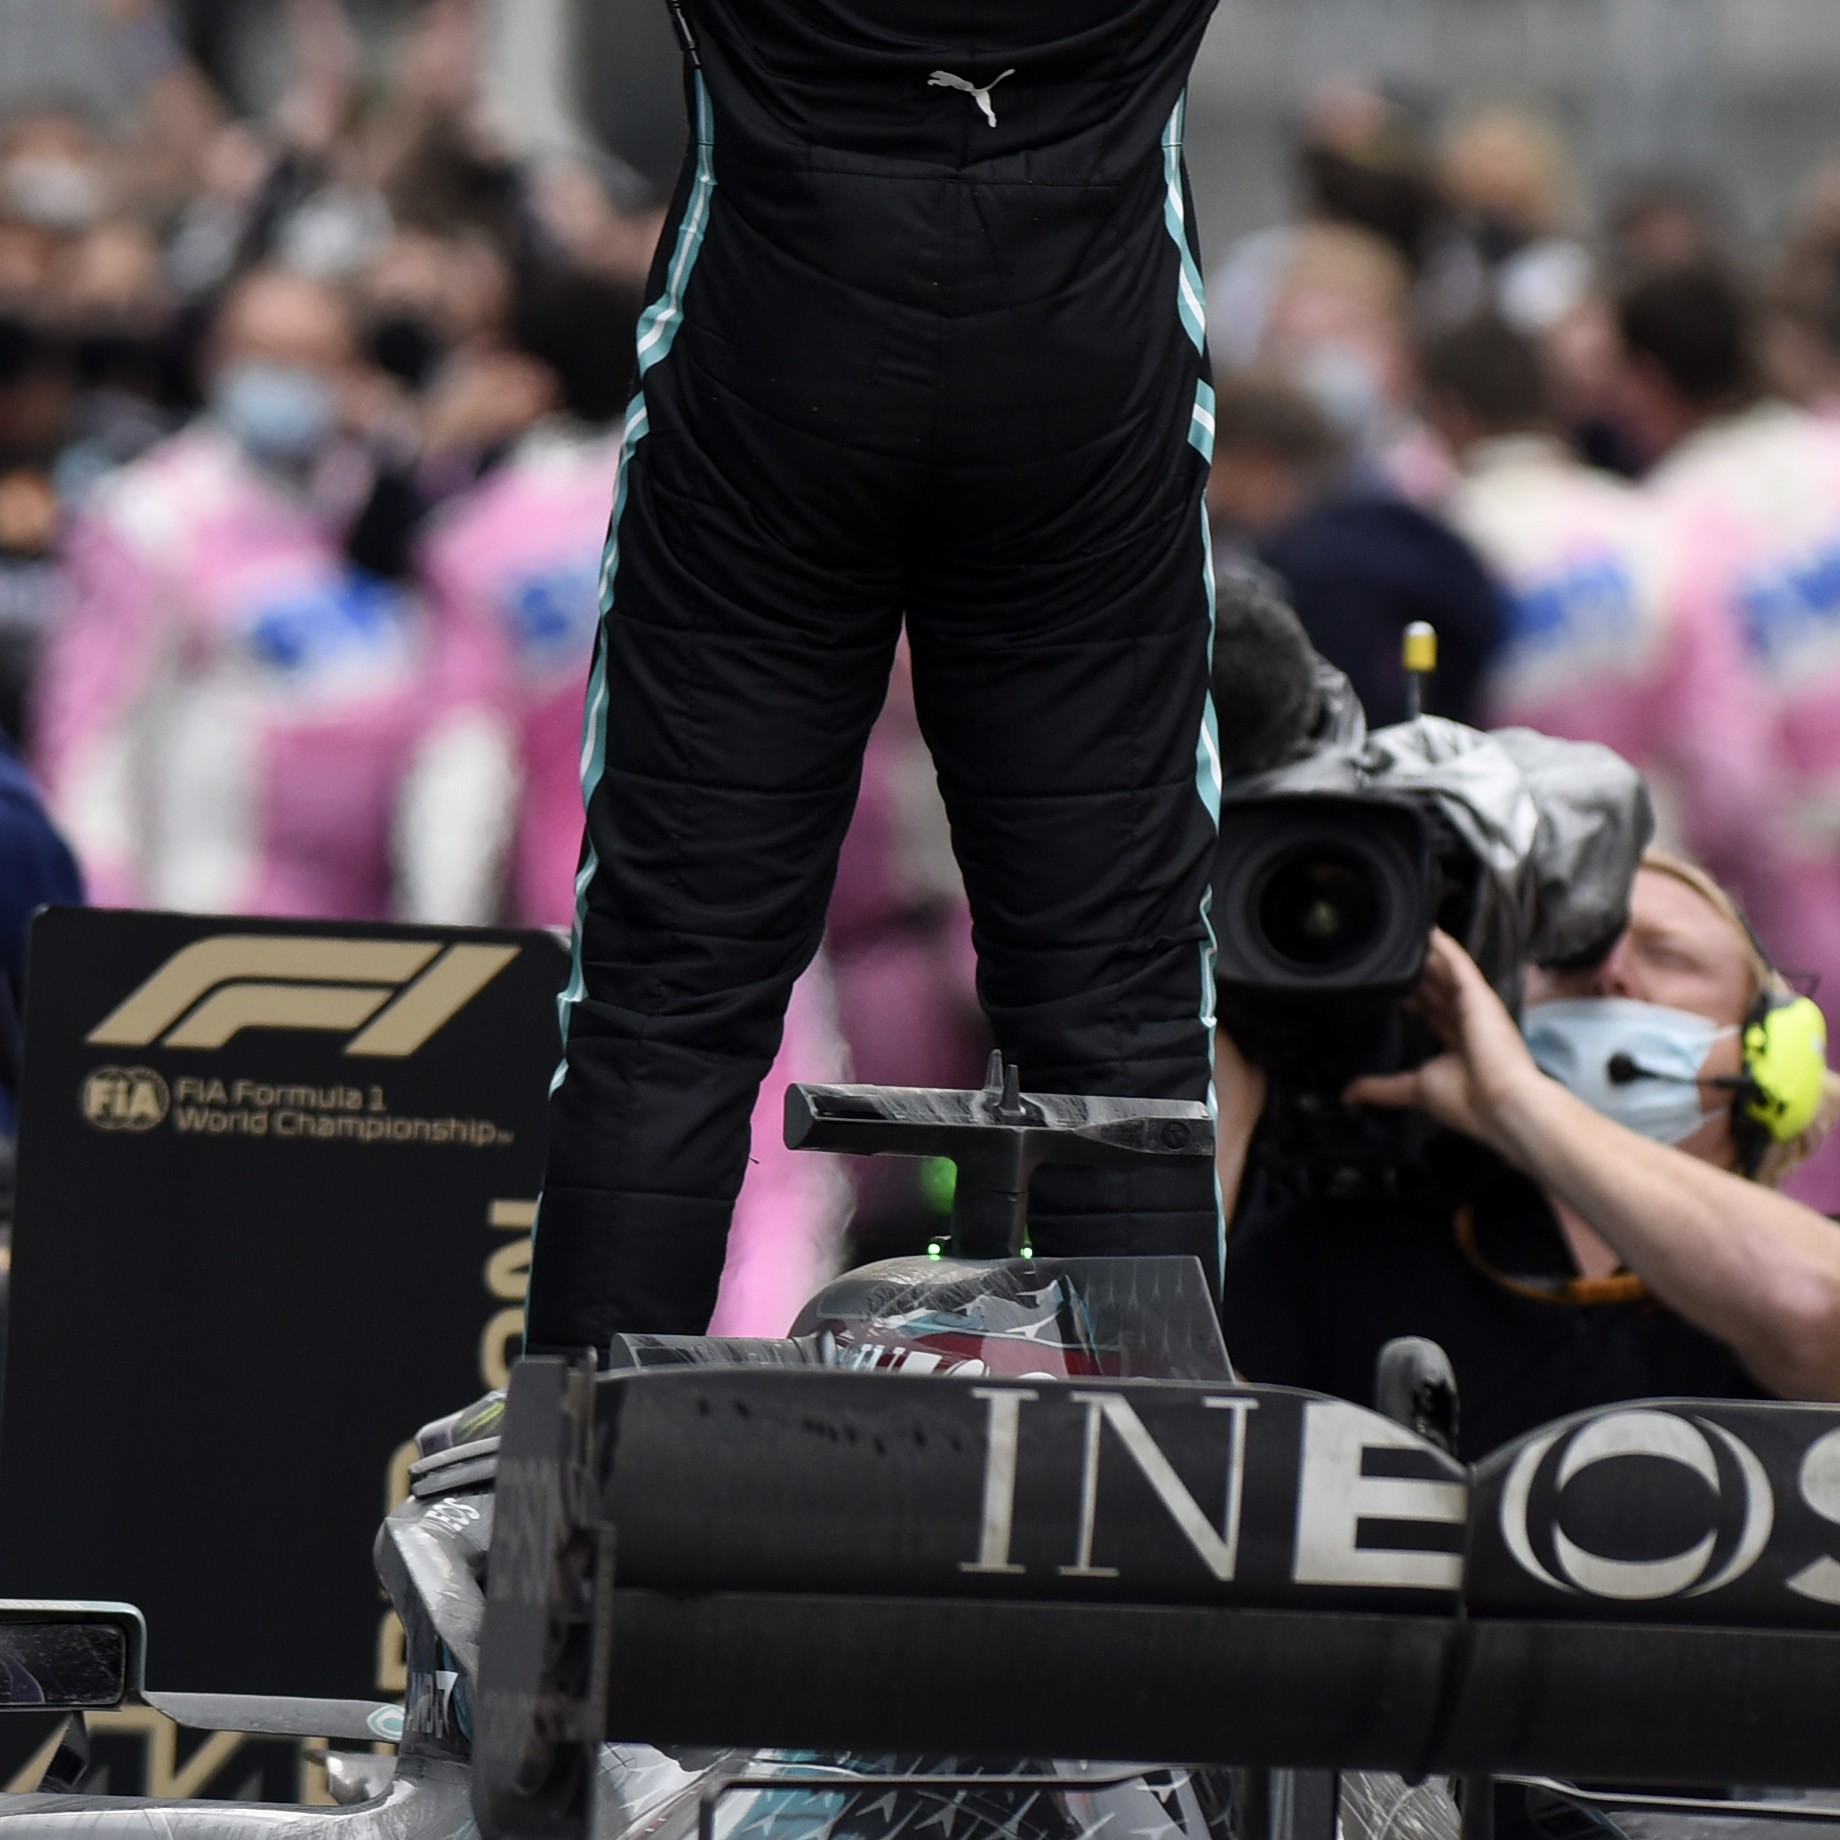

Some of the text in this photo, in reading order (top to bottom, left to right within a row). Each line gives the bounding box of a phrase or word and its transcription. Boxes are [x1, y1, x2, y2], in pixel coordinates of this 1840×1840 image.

[84, 932, 523, 1058] F1
[178, 1078, 387, 1111] FIA Formula 1
[177, 1107, 269, 1135] World
